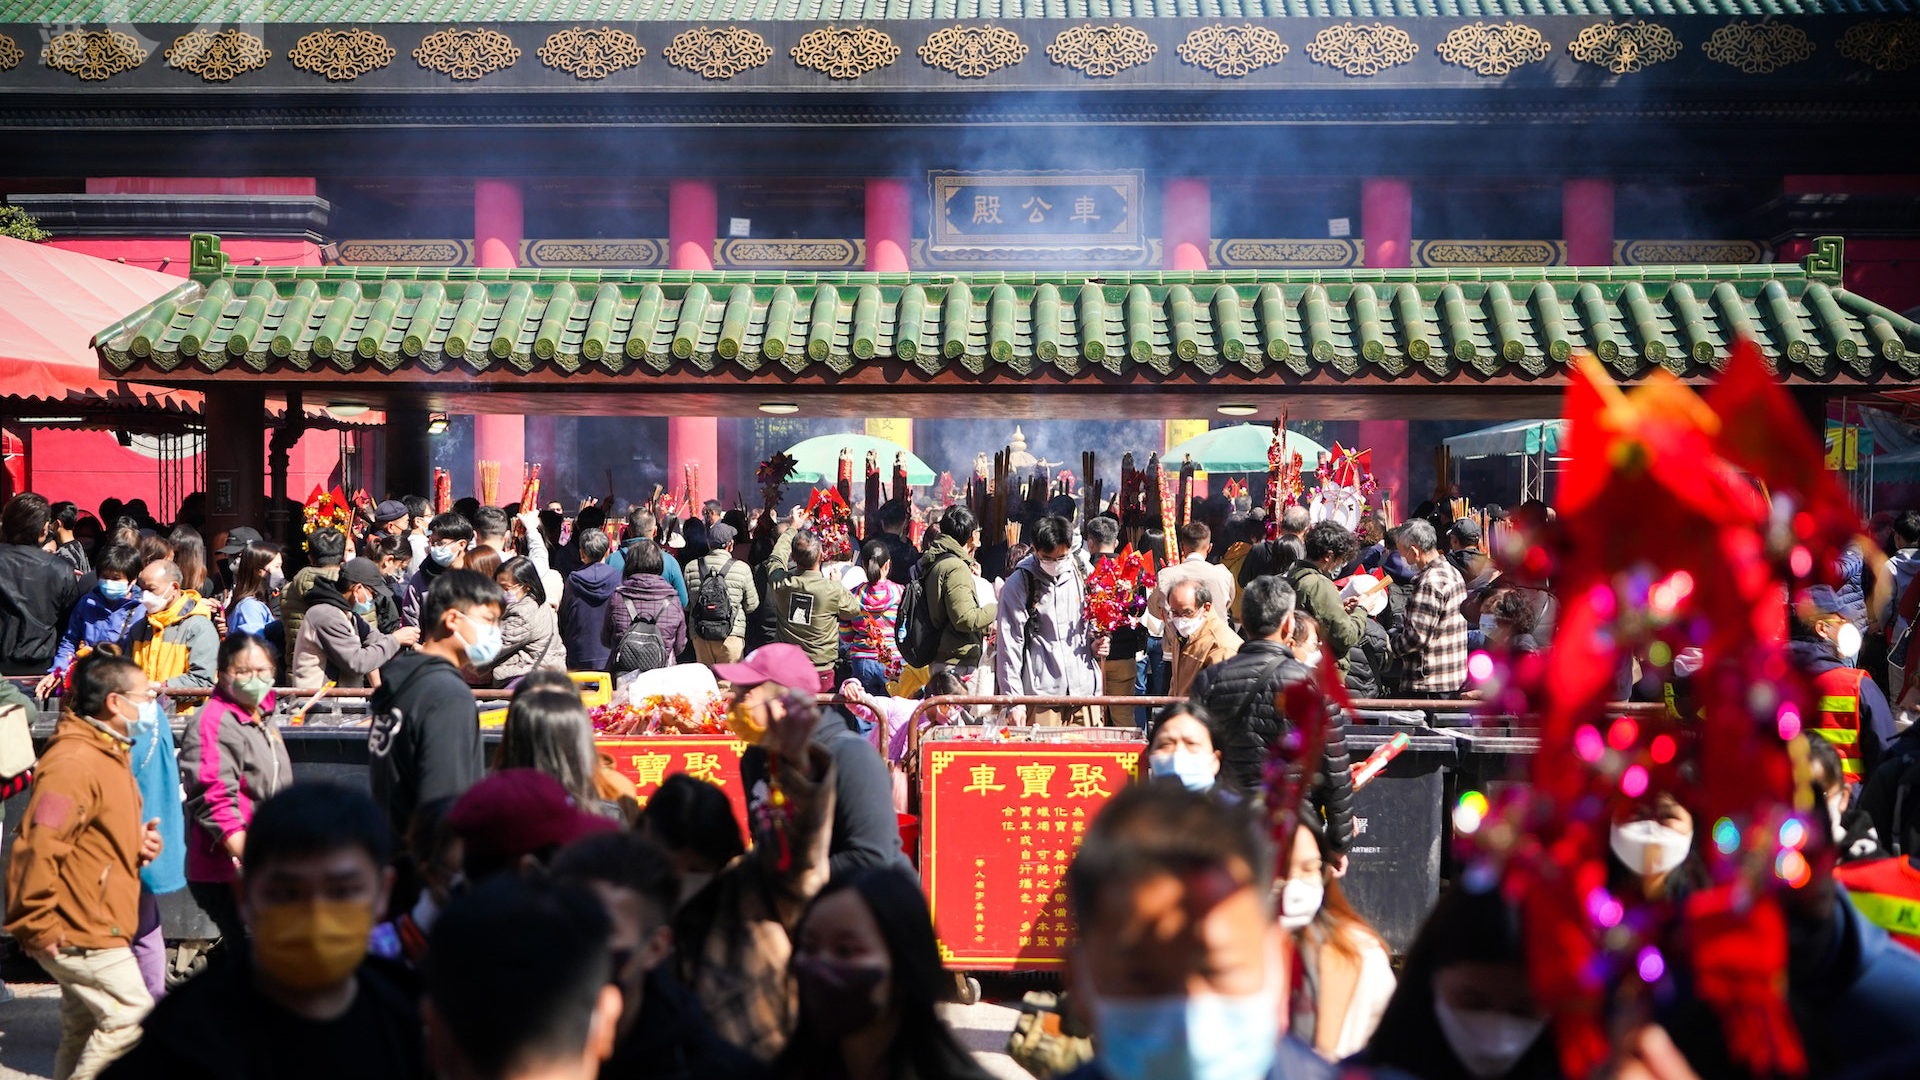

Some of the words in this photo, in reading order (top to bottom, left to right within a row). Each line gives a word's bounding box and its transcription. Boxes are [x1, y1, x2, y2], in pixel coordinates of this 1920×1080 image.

[631, 751, 727, 788] 聚寶
[963, 762, 1112, 799] 聚寶車
